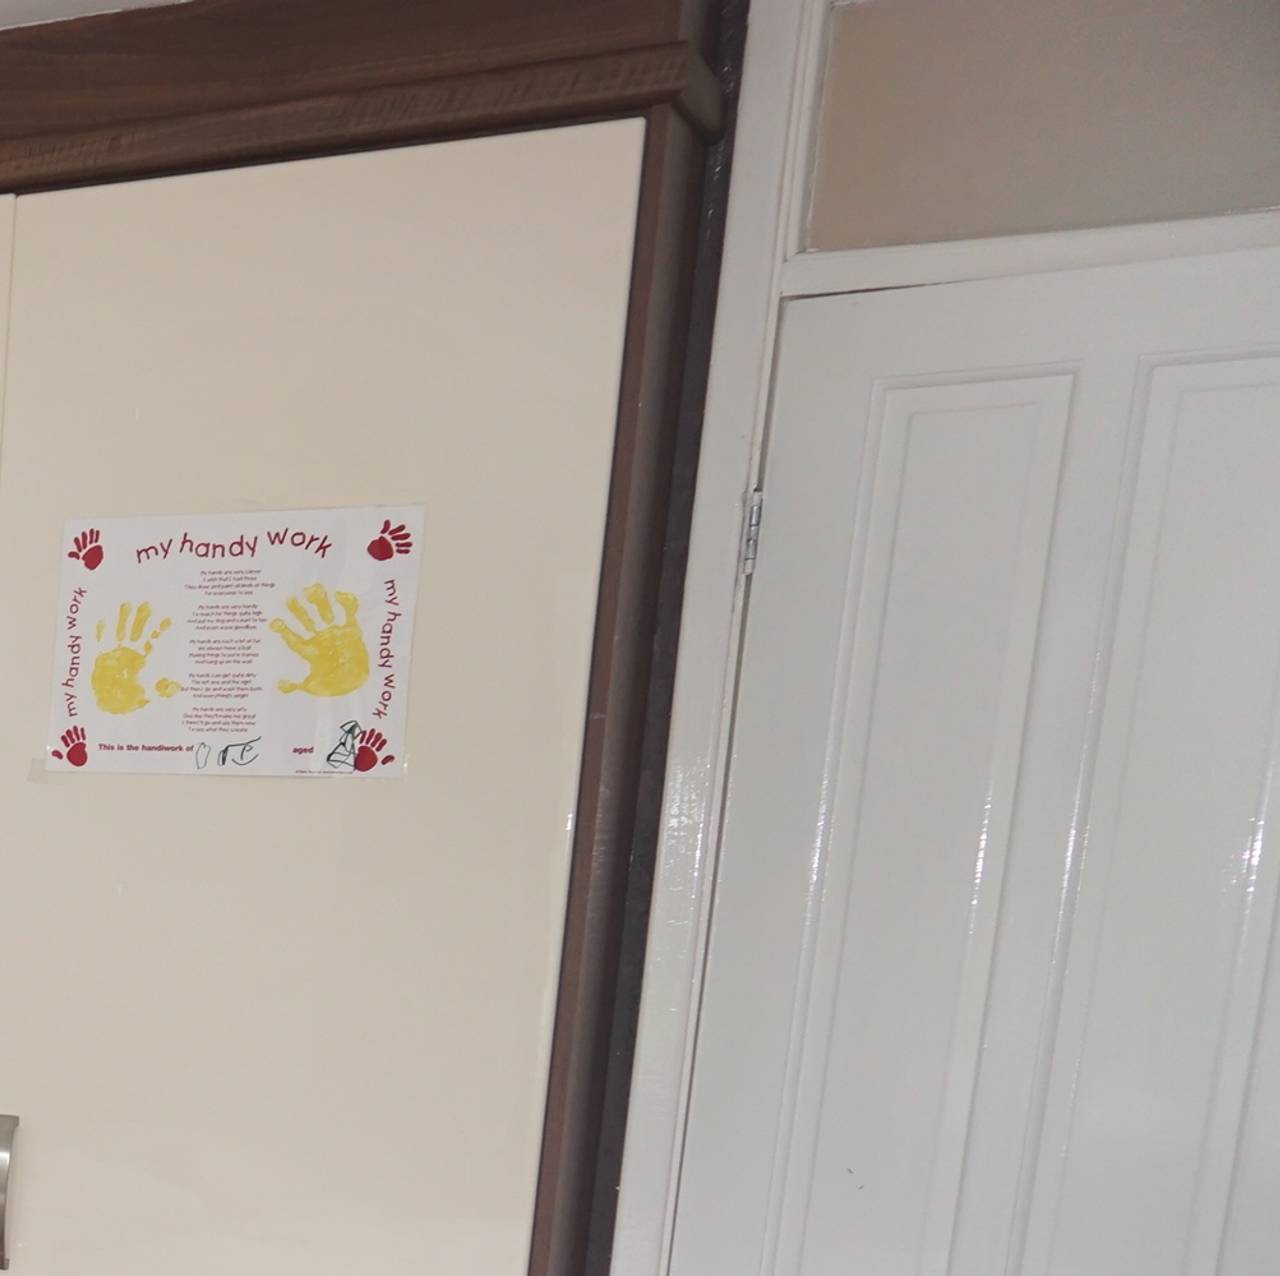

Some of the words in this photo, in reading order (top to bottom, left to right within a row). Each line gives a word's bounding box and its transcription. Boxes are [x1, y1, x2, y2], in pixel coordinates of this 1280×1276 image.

[136, 538, 173, 564] my
[179, 532, 258, 559] handy
[267, 528, 333, 559] work
[66, 587, 87, 630] work
[384, 579, 400, 606] my
[378, 611, 402, 668] handy
[61, 635, 82, 688] handy
[64, 693, 79, 718] my
[372, 674, 396, 720] work
[98, 743, 115, 751] This
[126, 744, 139, 752] the
[141, 744, 183, 752] handiwork
[292, 746, 314, 755] aged
